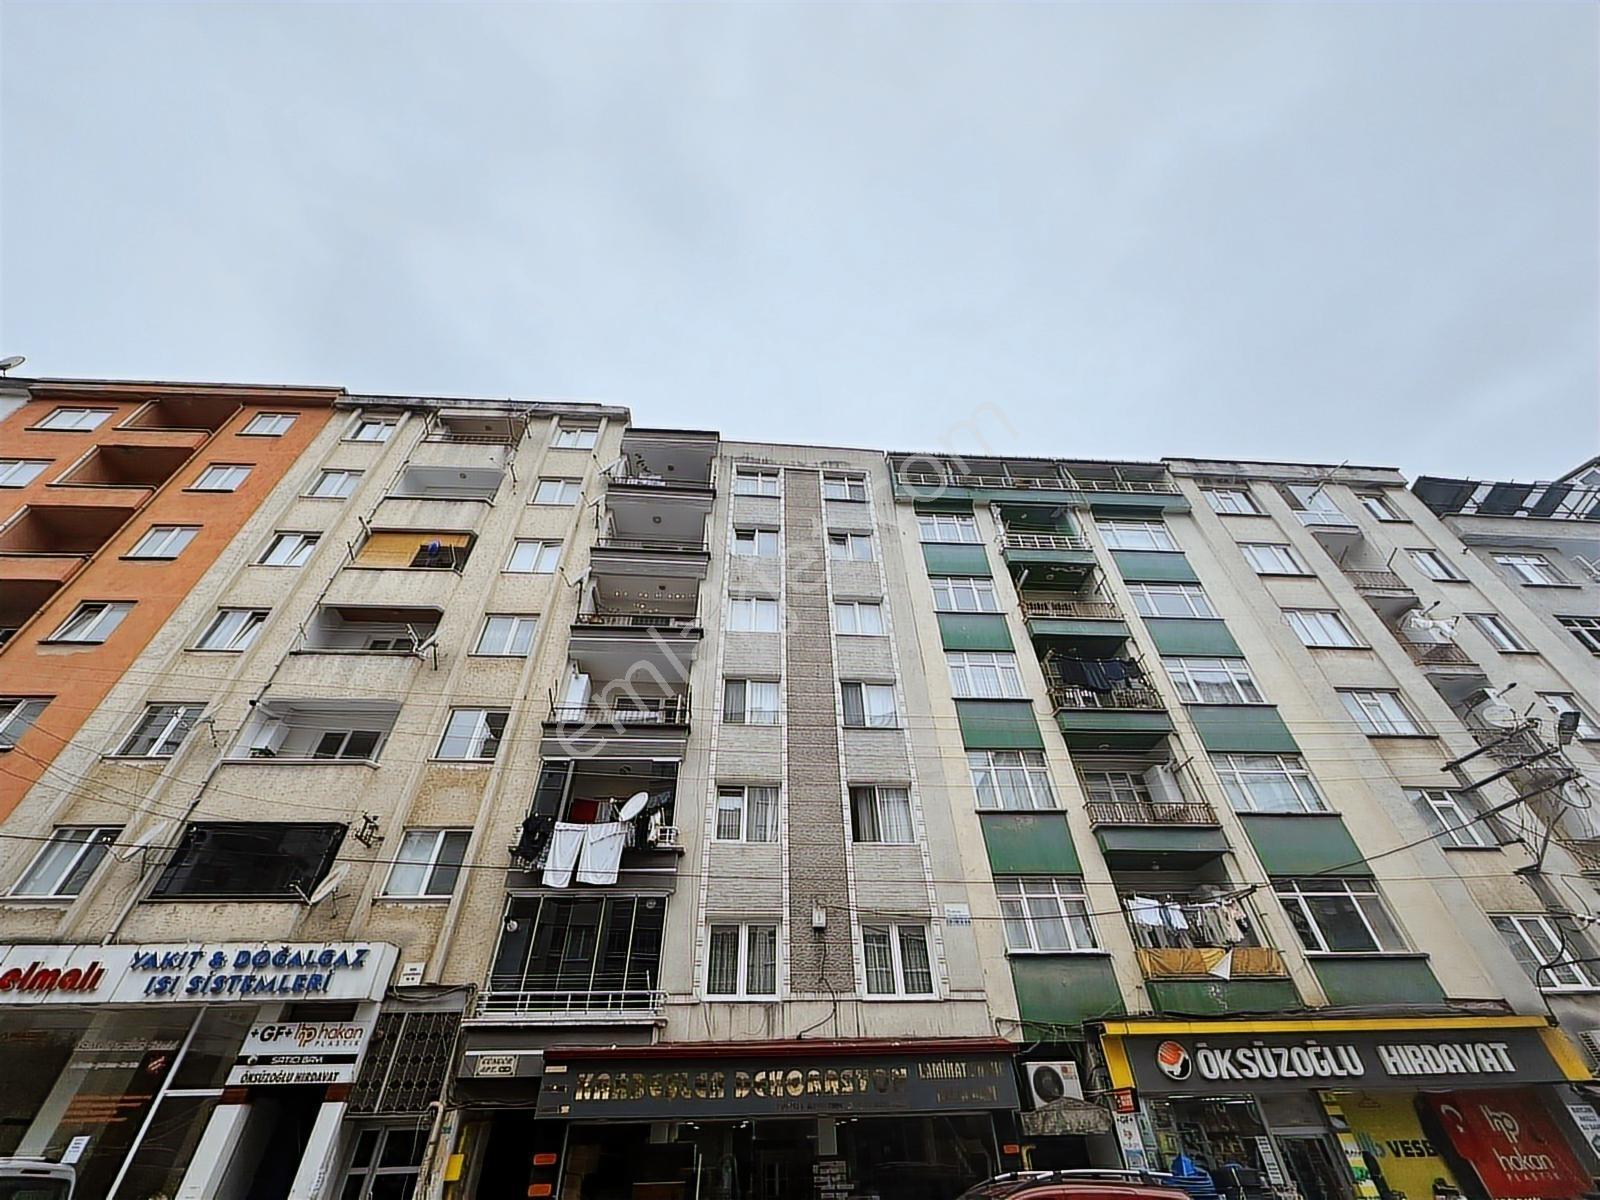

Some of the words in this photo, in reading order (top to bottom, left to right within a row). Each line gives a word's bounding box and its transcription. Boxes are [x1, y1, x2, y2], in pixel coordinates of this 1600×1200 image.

[131, 951, 204, 970] YAKIT
[208, 951, 227, 969] &
[144, 975, 182, 995] ISI
[186, 969, 335, 995] SİSTEMLERİ
[317, 1022, 363, 1040] hakan
[1195, 1040, 1365, 1080] ÖKSÜZOĞLU
[1378, 1043, 1517, 1075] HIRDAVAT
[294, 1071, 340, 1083] HIRDAVAT
[1492, 1146, 1555, 1171] hakan
